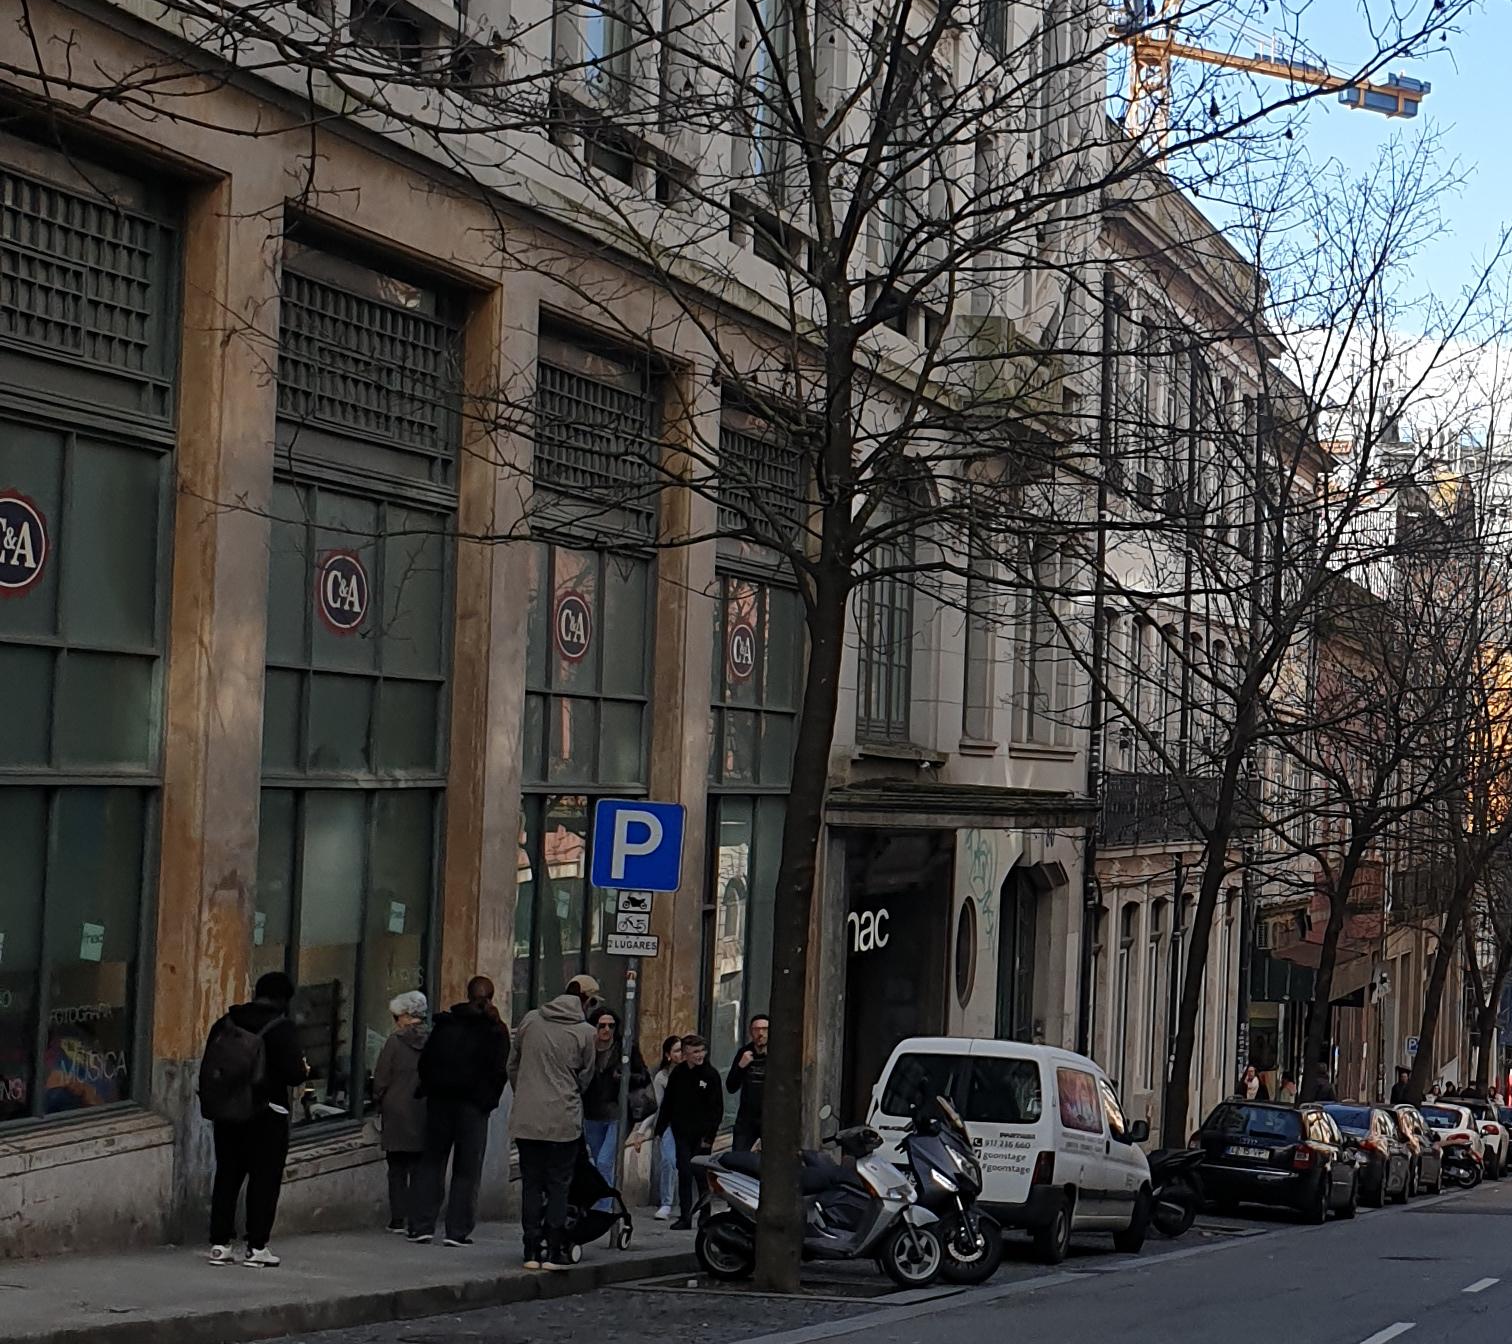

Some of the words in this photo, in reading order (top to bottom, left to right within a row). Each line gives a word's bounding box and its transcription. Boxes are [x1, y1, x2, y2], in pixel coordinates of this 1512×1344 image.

[326, 570, 362, 613] C&A
[560, 608, 586, 645] C&A
[733, 634, 753, 665] C&A
[610, 809, 664, 879] P
[614, 940, 657, 950] LUGARES
